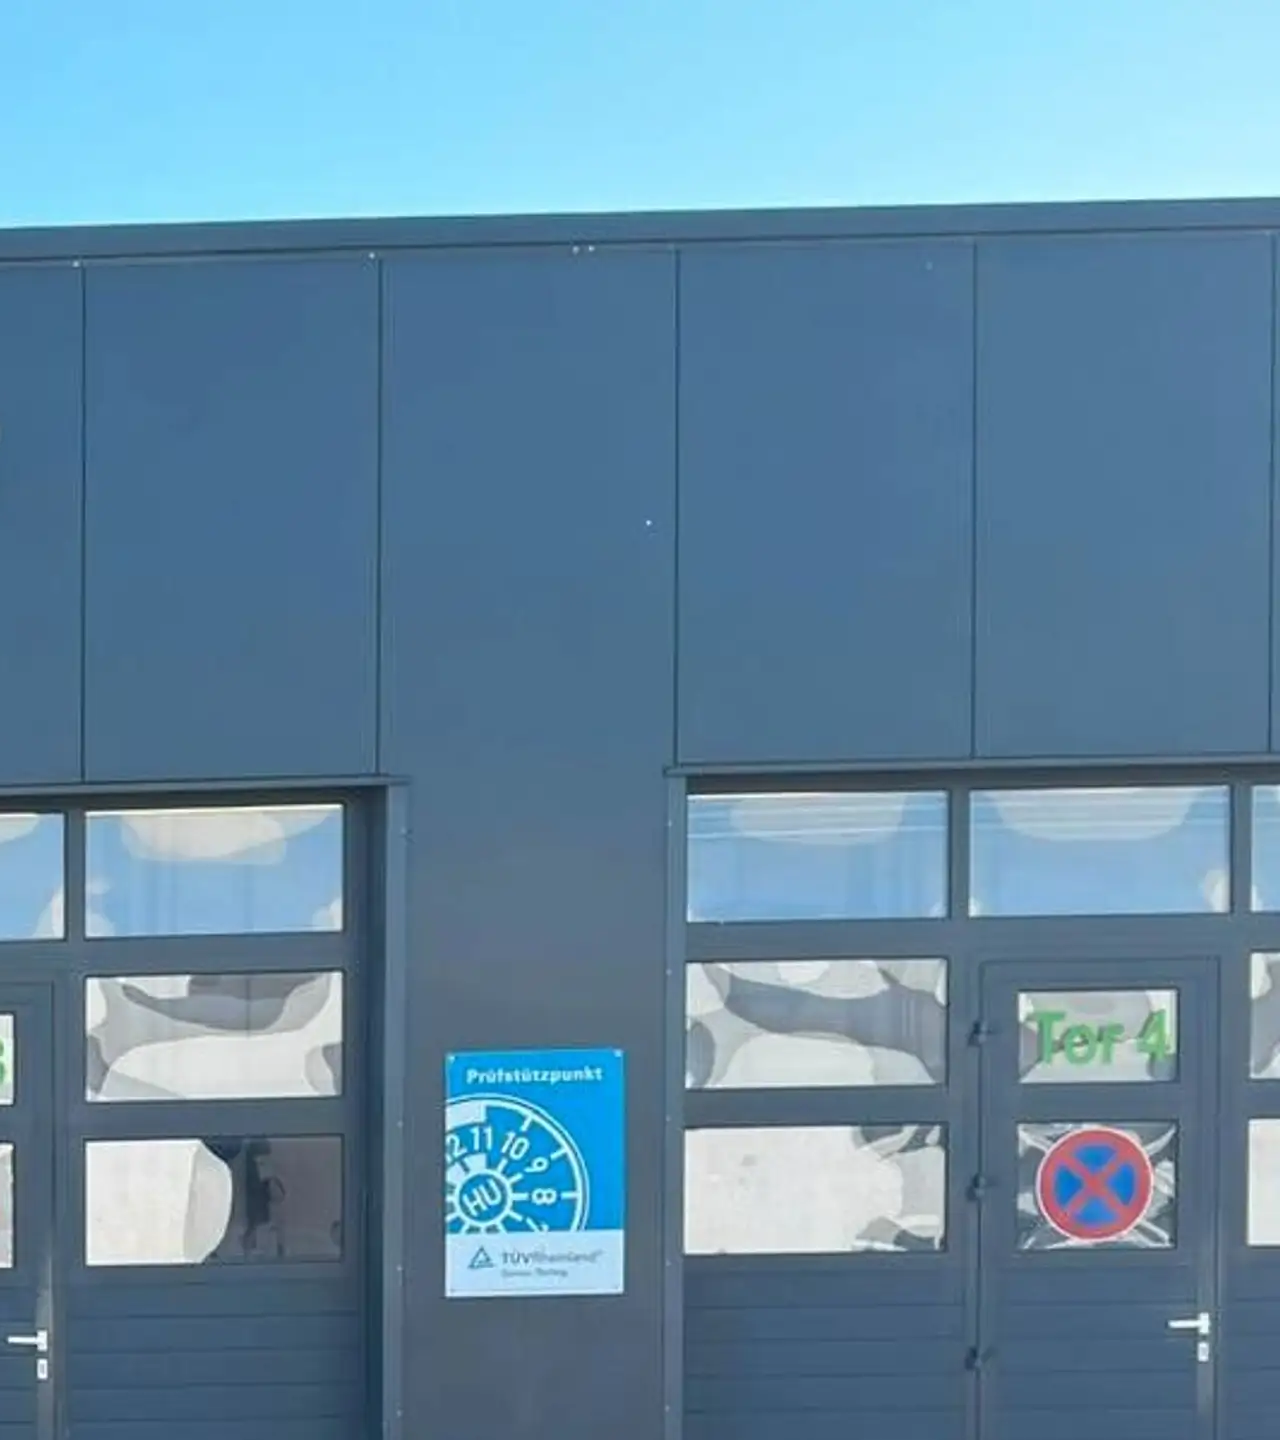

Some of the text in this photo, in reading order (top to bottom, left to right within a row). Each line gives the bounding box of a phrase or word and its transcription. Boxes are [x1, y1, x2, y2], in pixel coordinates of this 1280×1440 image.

[1026, 1009, 1170, 1066] Tor 4
[466, 1065, 603, 1086] Prüfstützpunkt
[470, 1124, 492, 1151] 11
[501, 1130, 530, 1160] 10
[523, 1156, 550, 1174] 9
[462, 1178, 502, 1216] HU
[531, 1187, 557, 1205] 8
